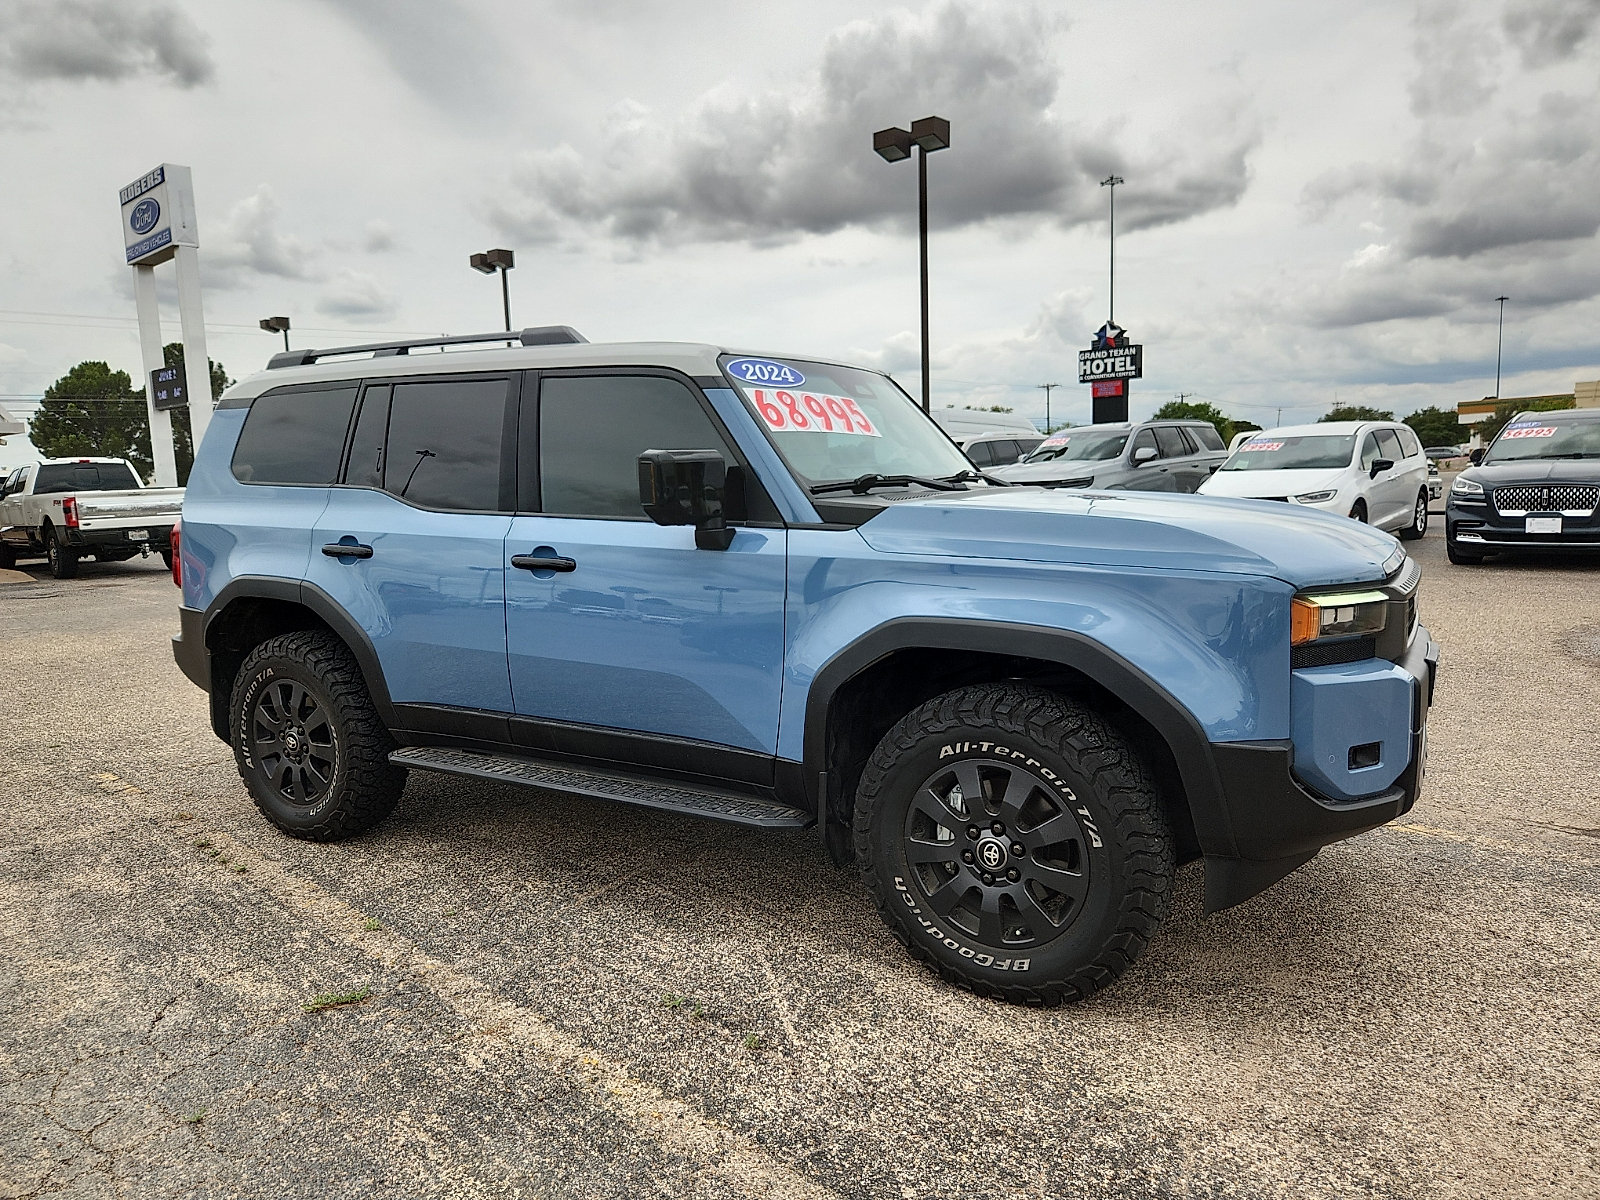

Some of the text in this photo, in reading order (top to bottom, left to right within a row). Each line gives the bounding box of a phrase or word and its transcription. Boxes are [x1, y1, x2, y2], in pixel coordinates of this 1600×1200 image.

[121, 168, 162, 204] ROGERS
[150, 230, 170, 248] VEHICLES
[1079, 346, 1136, 361] GRAND TEXAN
[741, 363, 795, 383] 2024
[1079, 356, 1136, 375] HOTEL
[1084, 372, 1116, 381] CONVENTION
[1116, 370, 1136, 378] CENTER
[754, 389, 873, 433] 68995
[1502, 427, 1554, 439] 56995
[255, 667, 275, 683] T/A
[939, 741, 1104, 849] All-Terrain T/A
[893, 876, 1032, 972] BFGoodrich
